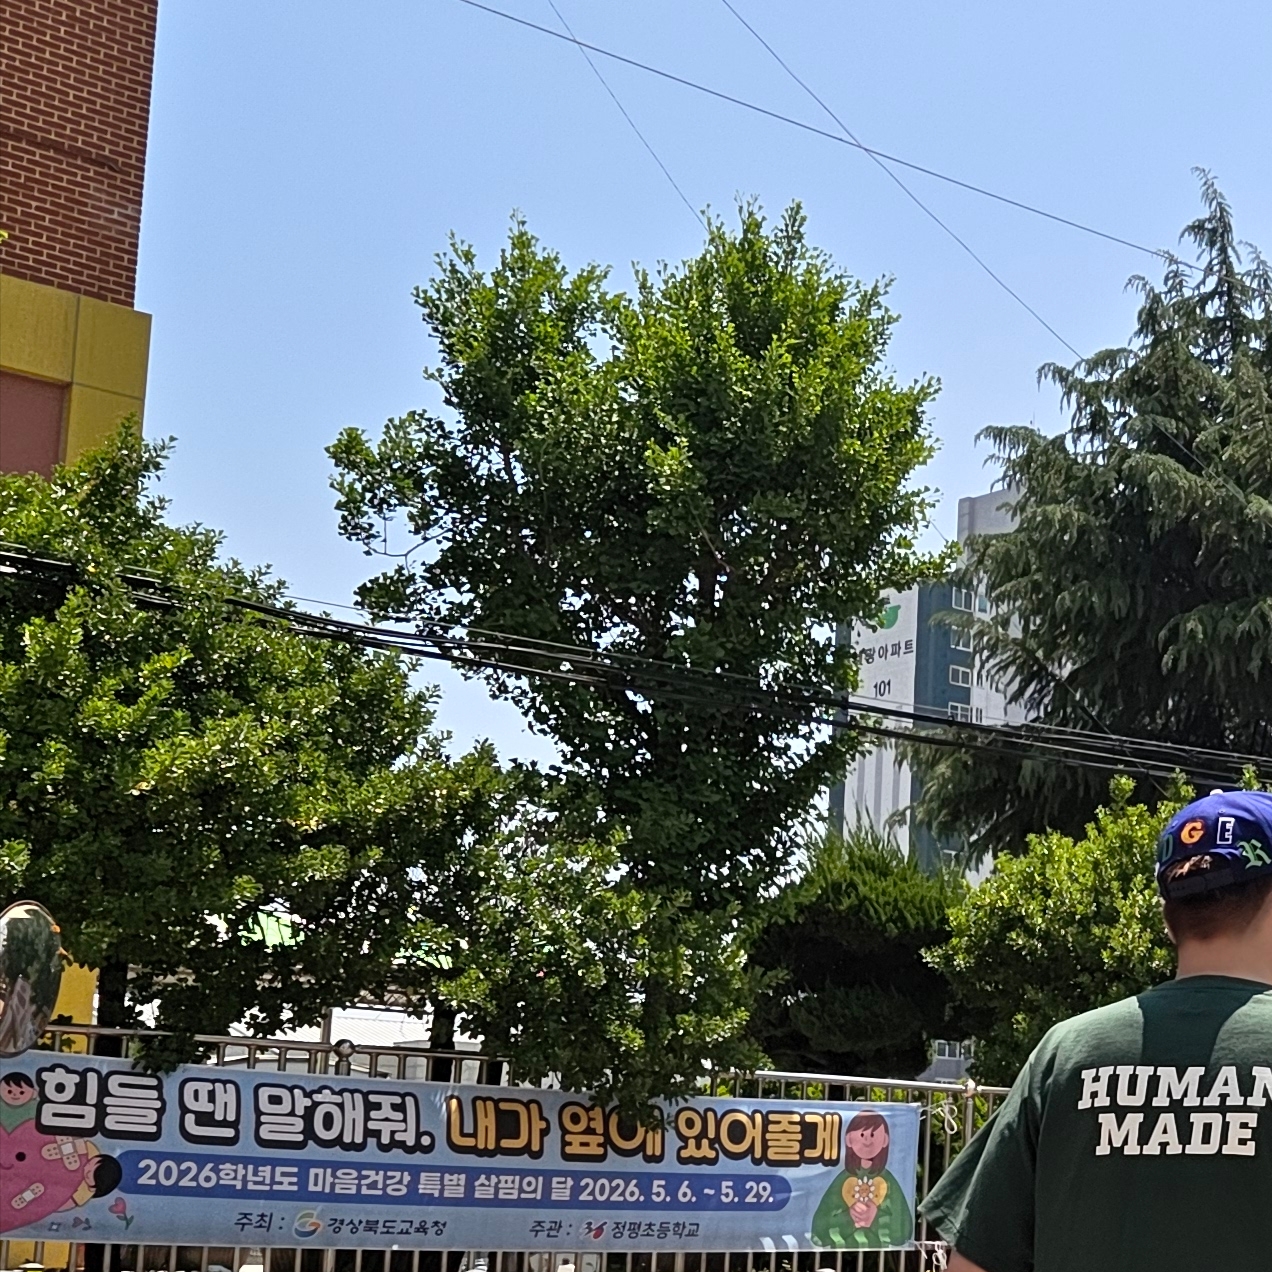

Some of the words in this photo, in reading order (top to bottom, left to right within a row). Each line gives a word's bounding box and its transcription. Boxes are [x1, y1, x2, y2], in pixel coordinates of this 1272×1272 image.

[873, 679, 891, 698] 101
[1180, 818, 1206, 845] G
[1216, 816, 1236, 845] E
[39, 1066, 163, 1136] 힘들
[181, 1079, 238, 1141] 땐
[256, 1084, 433, 1149] 말해줘.
[448, 1096, 548, 1155] 내가
[560, 1103, 663, 1158] 옆에
[676, 1107, 842, 1163] 있어줄게
[1095, 1112, 1258, 1156] MADE
[137, 1158, 299, 1192] 2026학년도
[308, 1166, 411, 1196] 마음건강
[418, 1171, 466, 1199] 특별
[474, 1173, 544, 1200] 살핌의
[551, 1176, 573, 1201] 달
[579, 1178, 645, 1202] 2026.
[745, 1180, 774, 1204] 29.
[327, 1217, 448, 1236] 경상북도교육청
[611, 1220, 701, 1239] 정평초등학교
